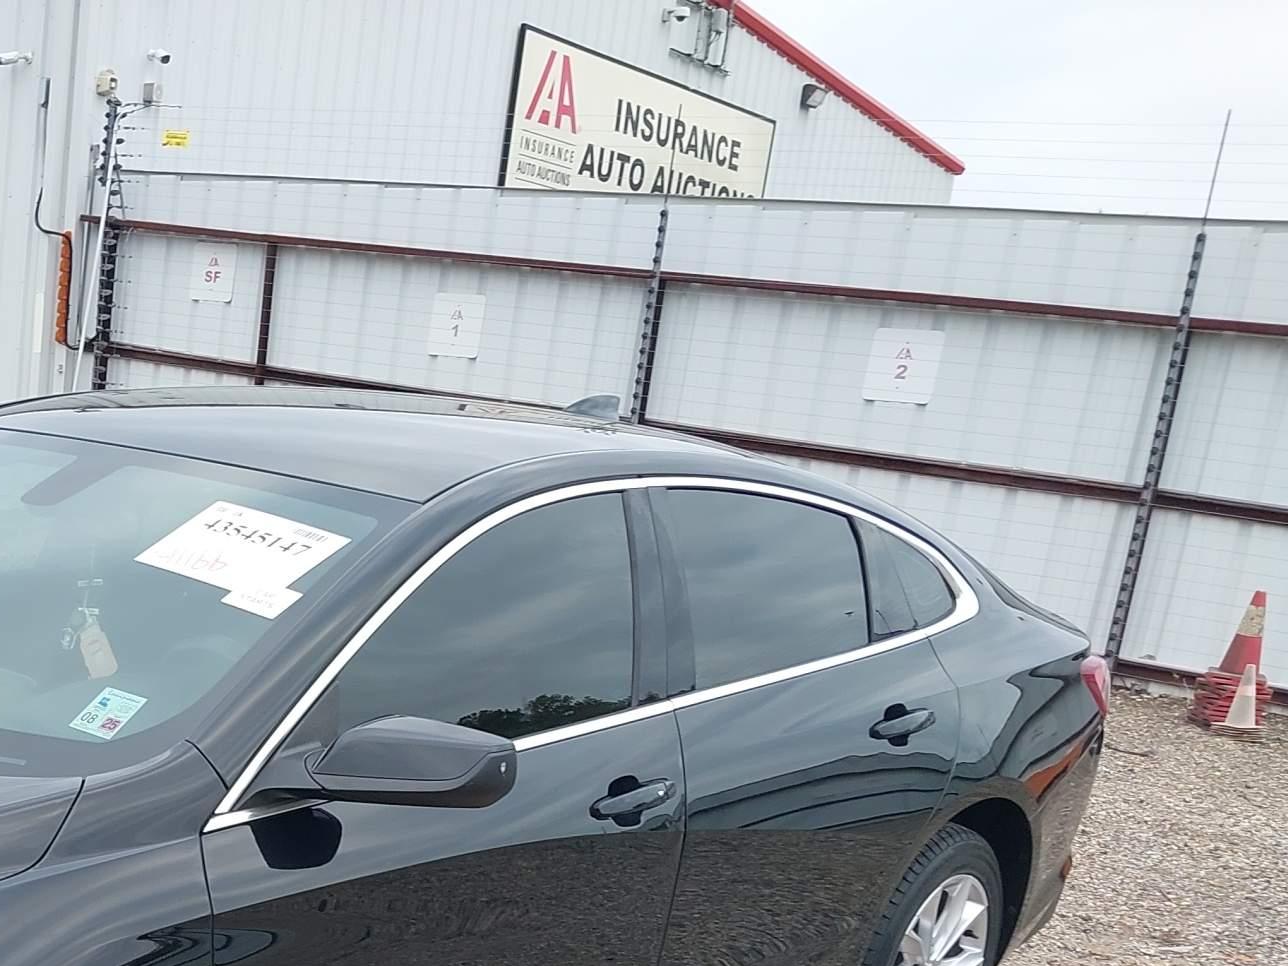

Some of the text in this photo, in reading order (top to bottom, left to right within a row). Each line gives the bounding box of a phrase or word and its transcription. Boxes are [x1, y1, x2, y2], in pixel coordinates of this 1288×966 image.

[614, 98, 742, 172] INSURANCE
[519, 135, 576, 164] INSURANCE
[515, 159, 571, 187] AUTO AUCTIONS
[578, 143, 646, 192] AUTO
[204, 270, 222, 284] SF
[451, 324, 459, 337] 1
[893, 364, 909, 380] 2
[204, 519, 312, 556] 43545147
[80, 711, 99, 724] 08
